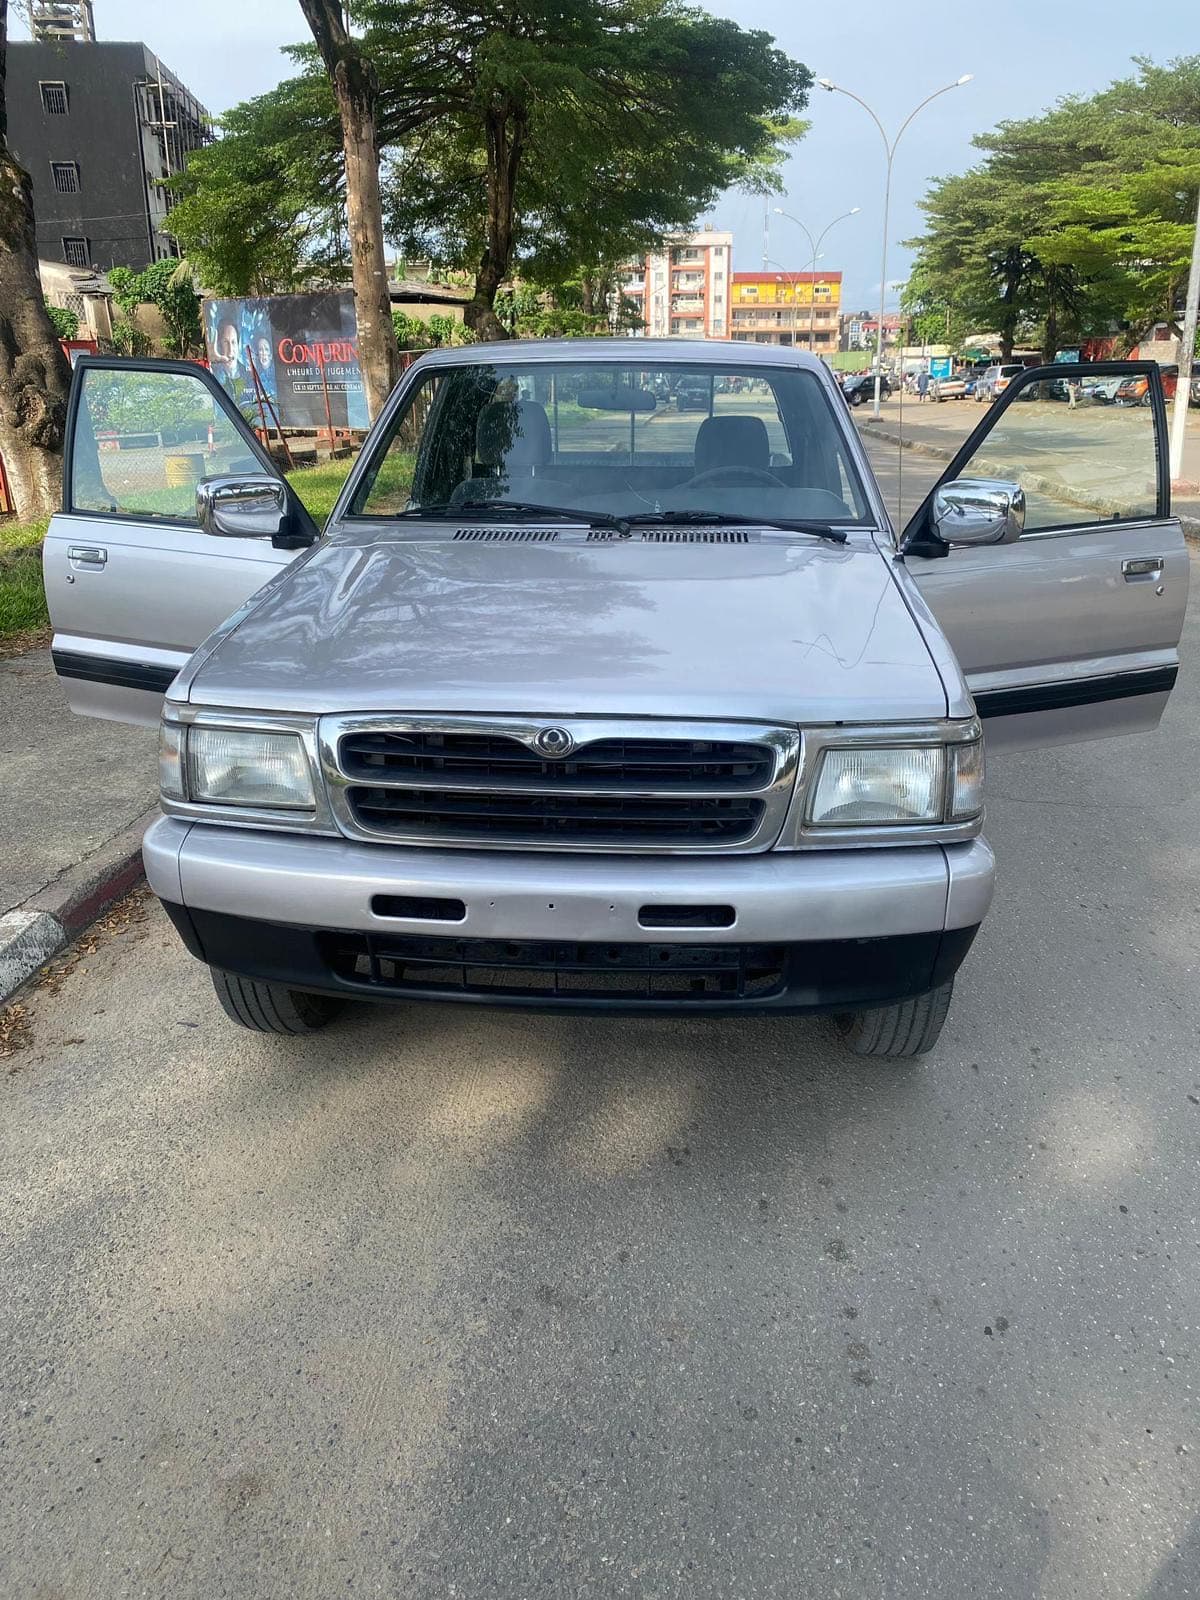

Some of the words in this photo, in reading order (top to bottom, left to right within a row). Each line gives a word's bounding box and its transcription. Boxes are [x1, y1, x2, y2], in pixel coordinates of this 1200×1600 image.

[278, 338, 360, 366] CONJURIN
[287, 367, 313, 376] L'HEURE
[328, 367, 361, 376] JUGEMEN
